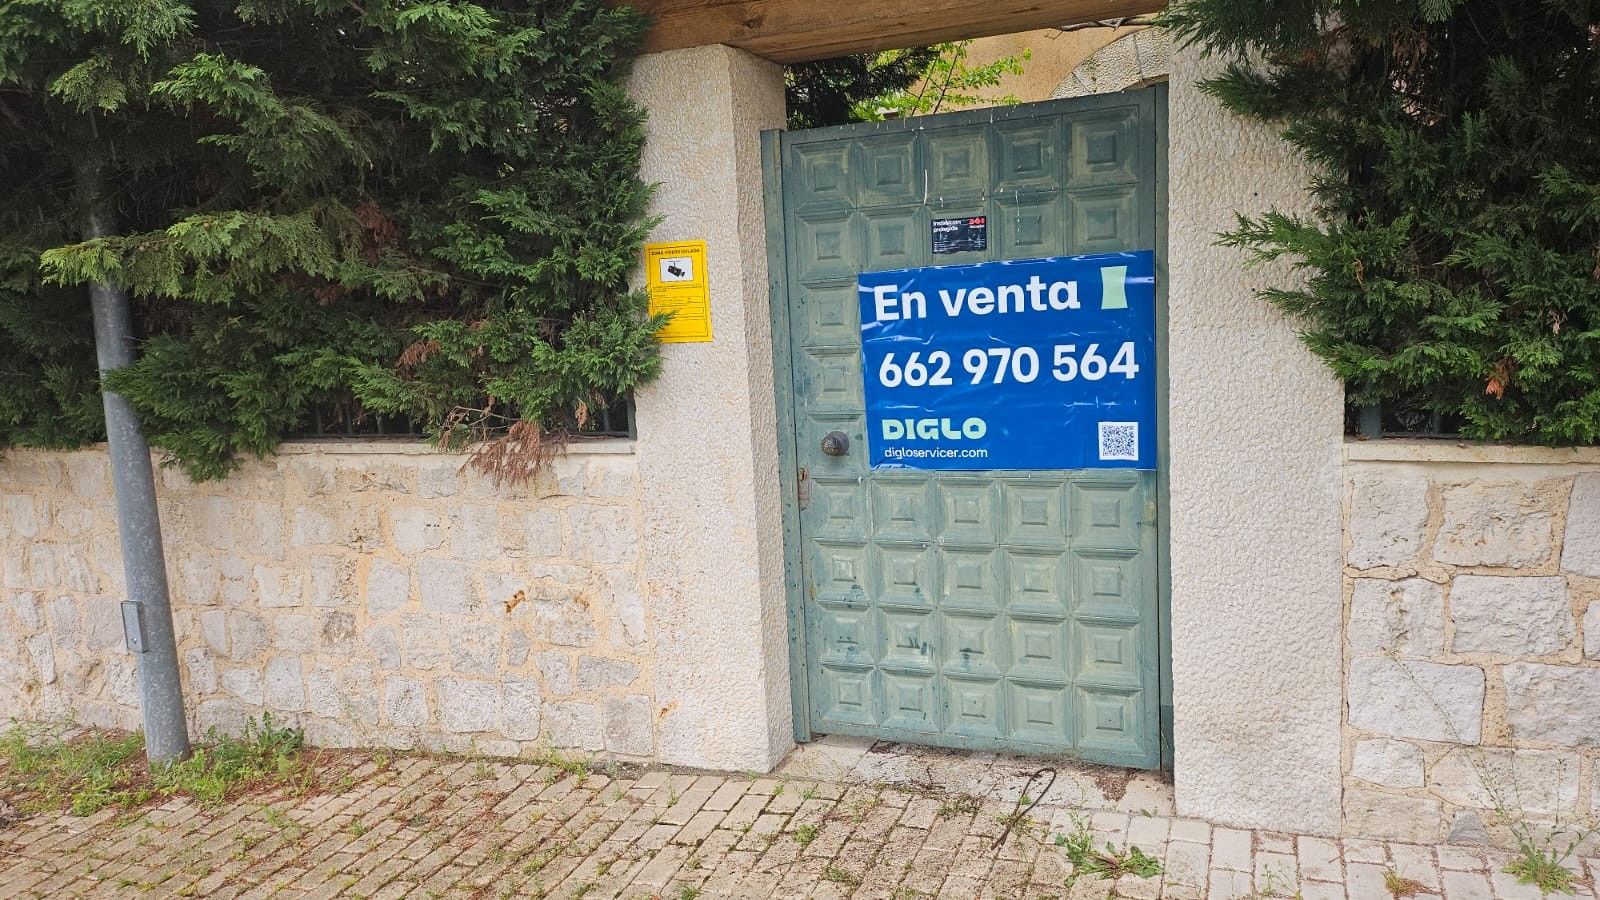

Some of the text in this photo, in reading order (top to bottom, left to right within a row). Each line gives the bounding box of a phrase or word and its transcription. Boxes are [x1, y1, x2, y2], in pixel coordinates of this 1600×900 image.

[874, 275, 1081, 321] En venta
[879, 341, 1140, 388] 662 970 564
[882, 417, 987, 440] DIGLO
[884, 446, 988, 460] digloservicer.com
